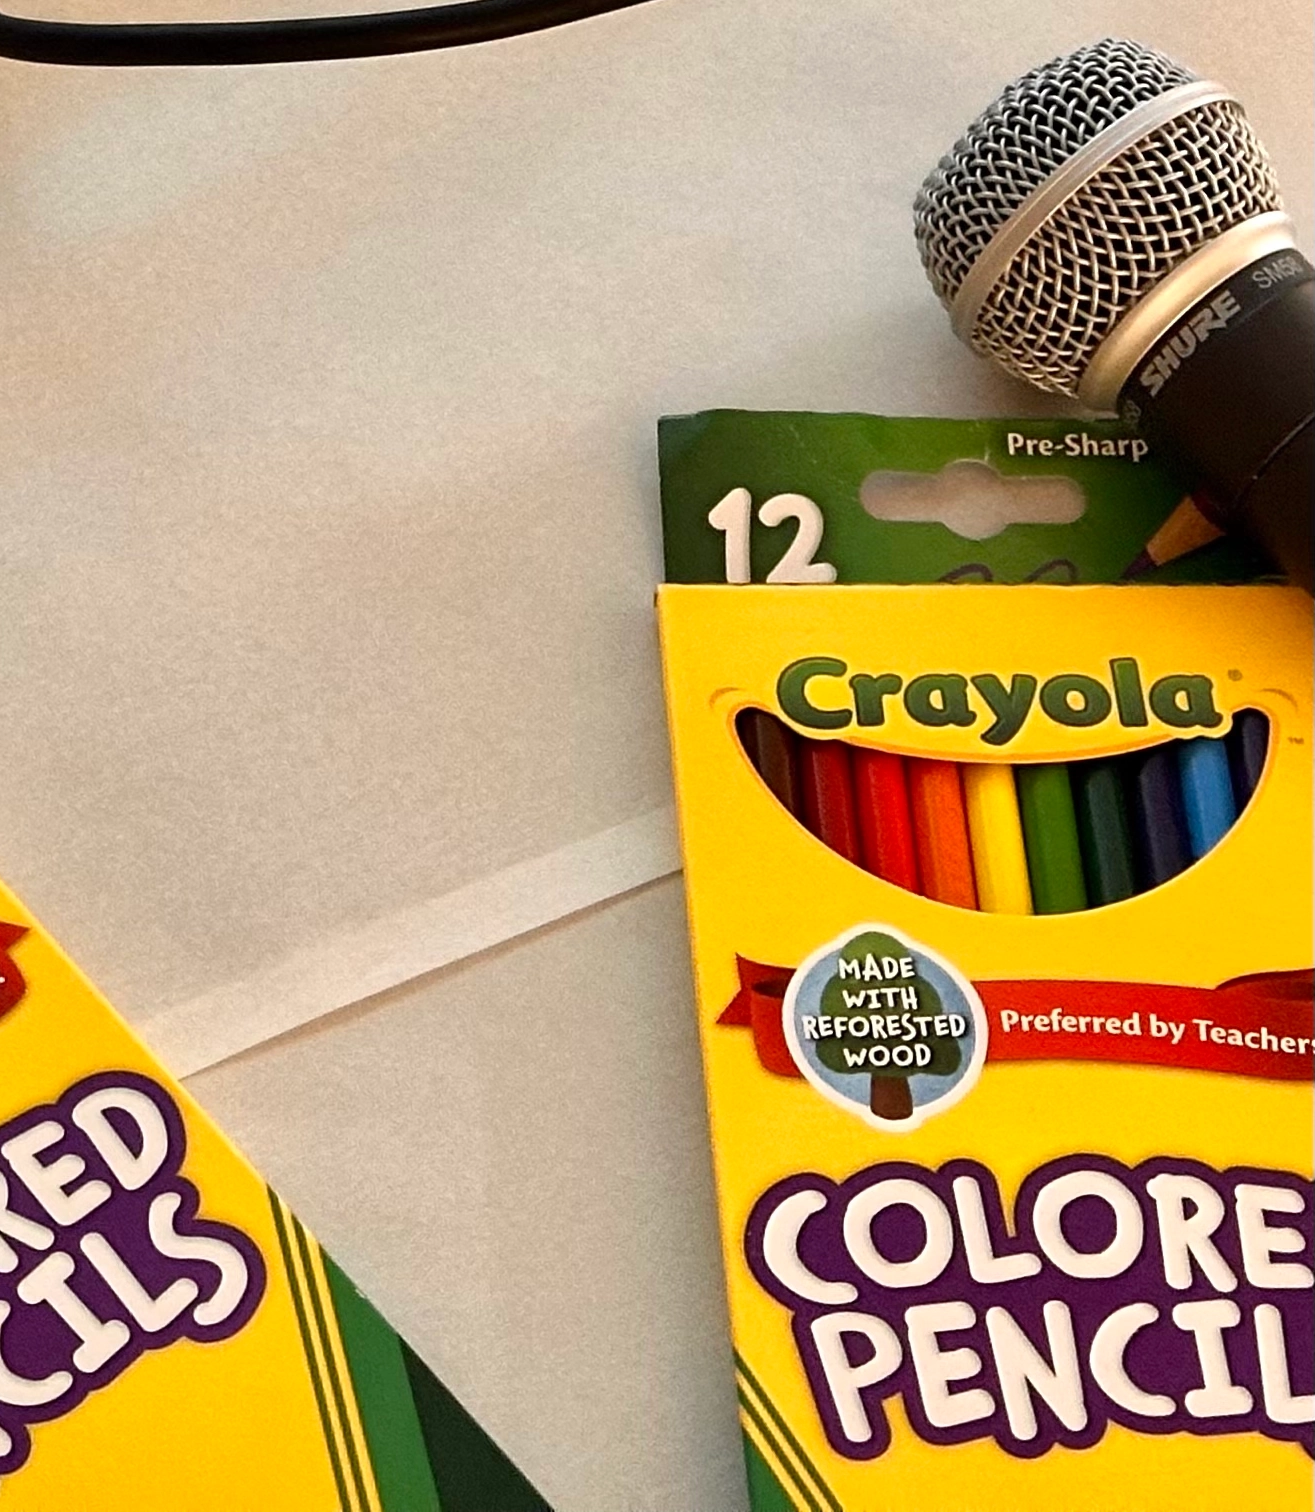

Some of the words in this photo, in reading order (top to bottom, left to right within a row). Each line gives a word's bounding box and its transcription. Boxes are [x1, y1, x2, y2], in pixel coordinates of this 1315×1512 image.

[1139, 289, 1243, 398] SHURE
[1007, 432, 1149, 462] Pre-Sharp
[708, 487, 838, 584] 12
[777, 656, 1223, 746] Crayola
[838, 956, 916, 981] MADE
[842, 986, 918, 1010] WITH
[802, 1014, 967, 1041] REFORESTED
[999, 1010, 1144, 1037] Preferred
[1150, 1015, 1185, 1044] by
[1191, 1018, 1315, 1055] Teacher
[843, 1044, 932, 1068] WOOD
